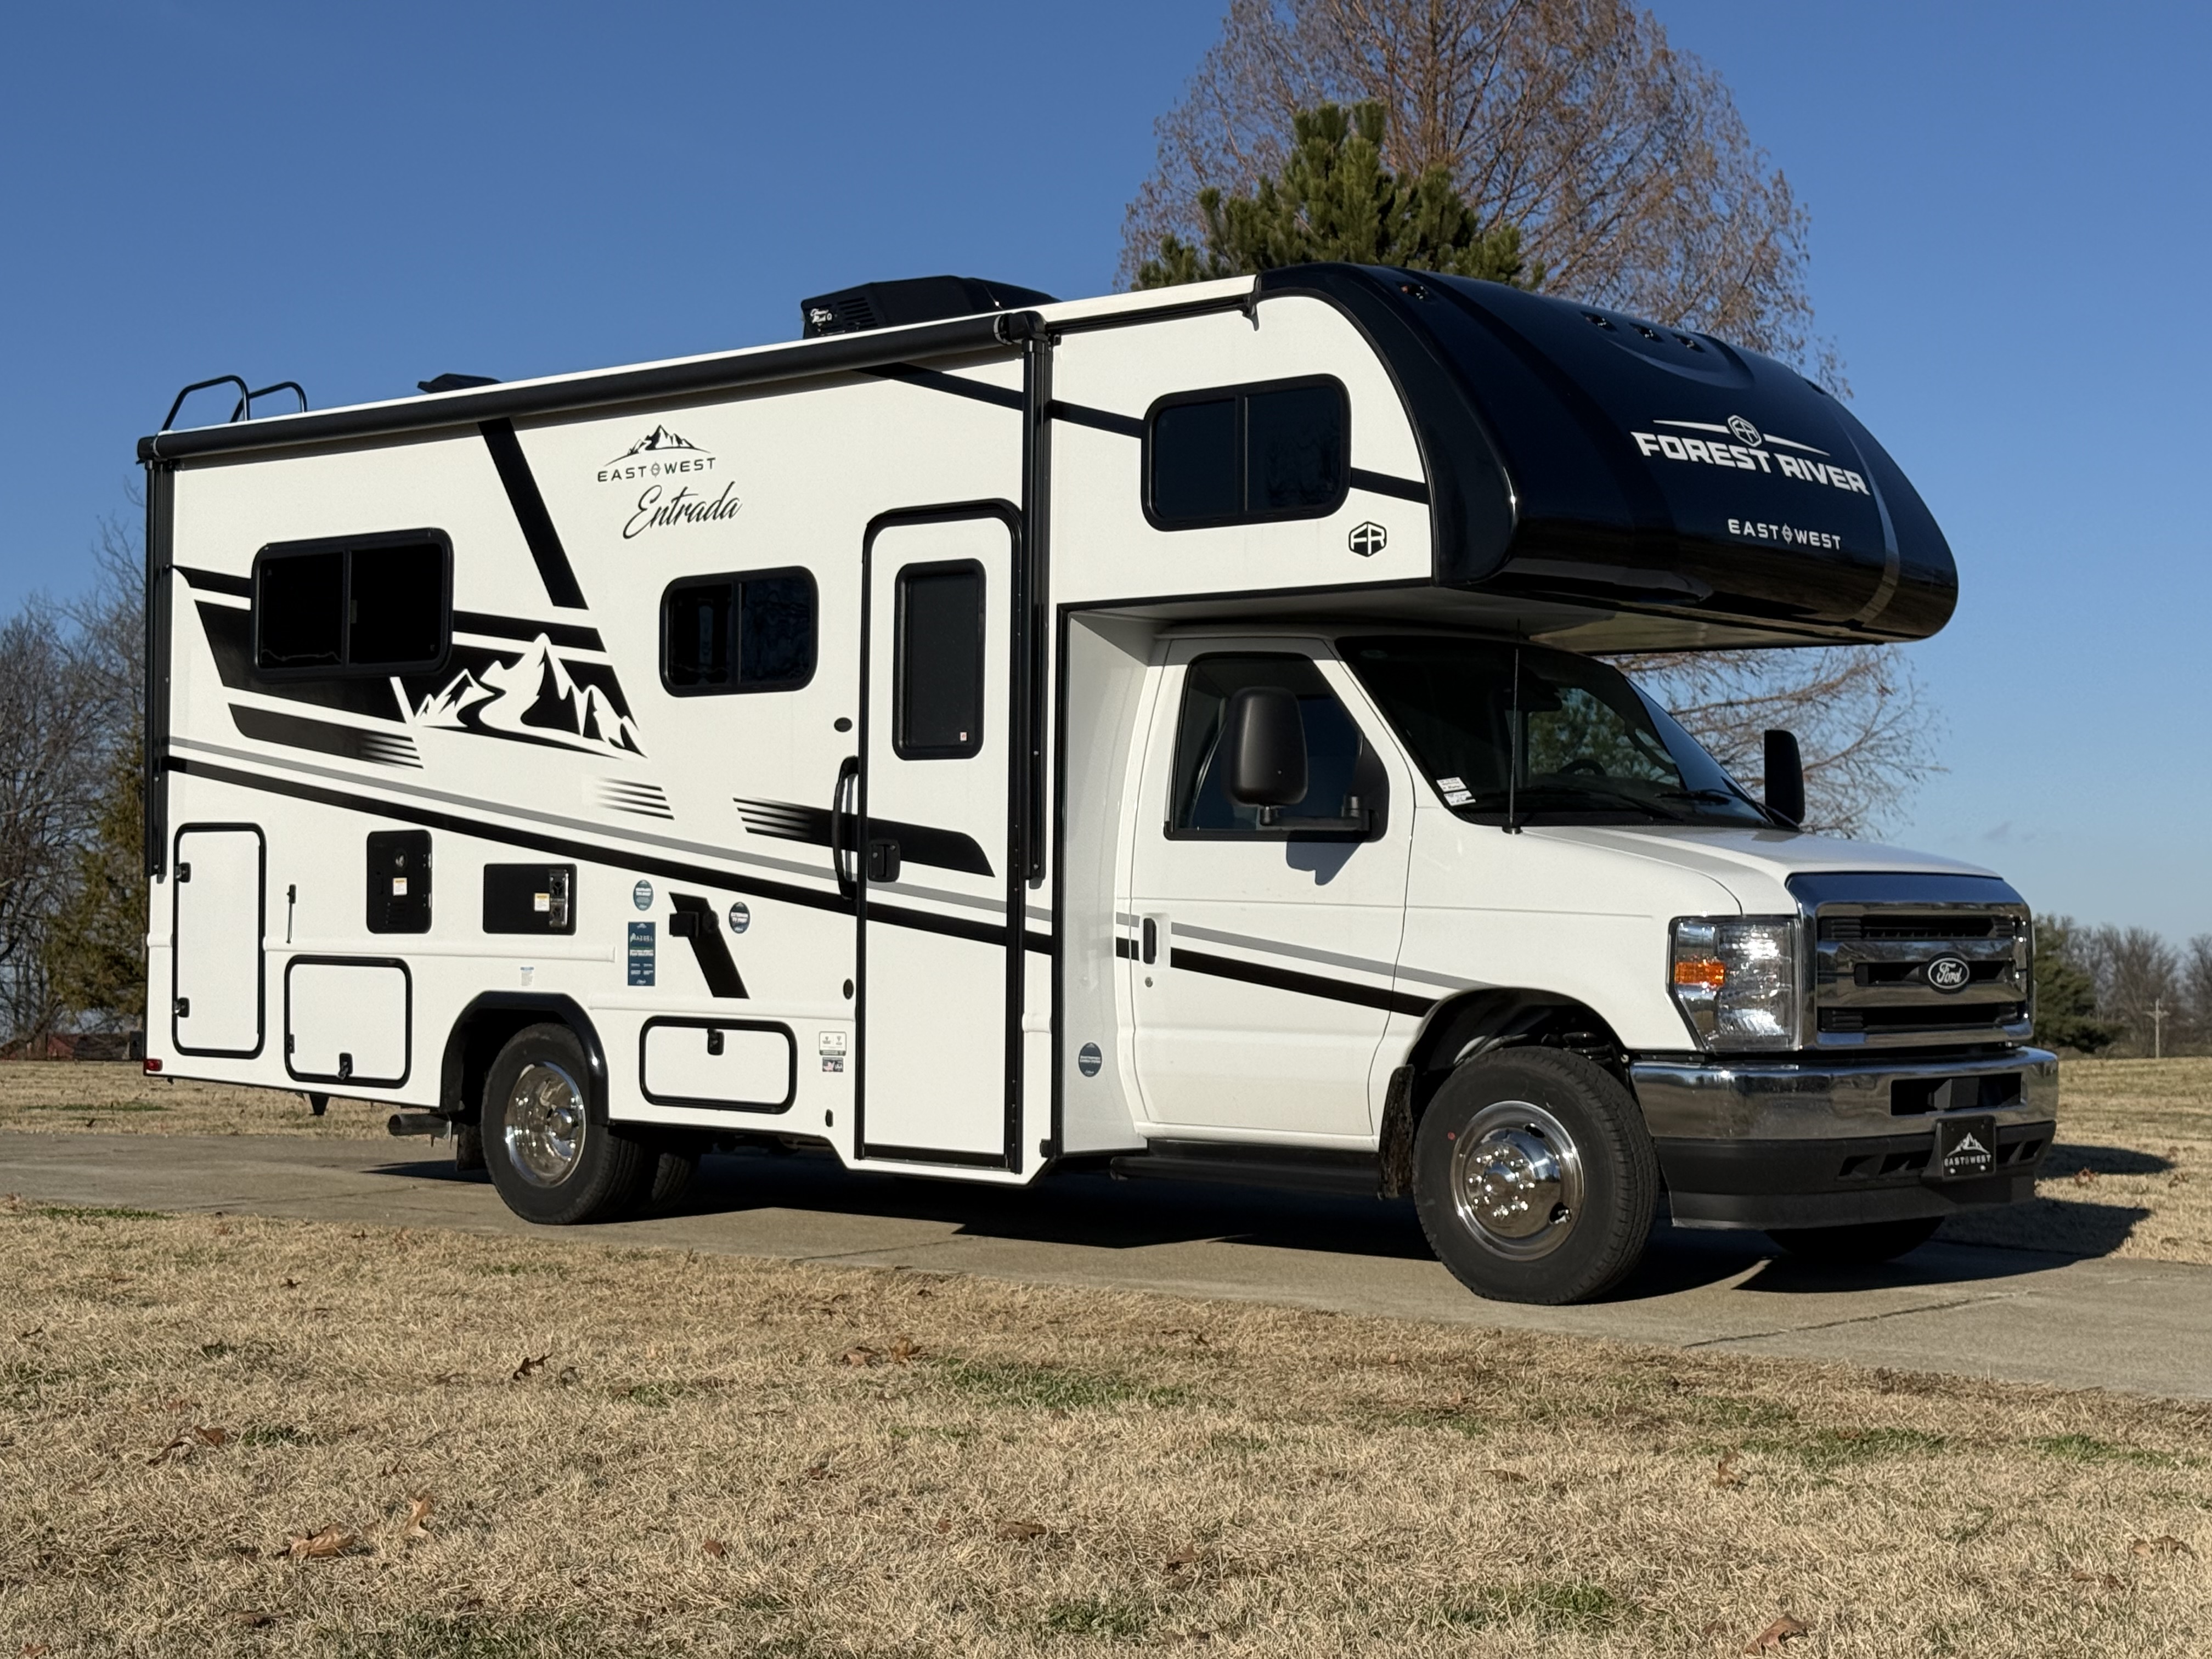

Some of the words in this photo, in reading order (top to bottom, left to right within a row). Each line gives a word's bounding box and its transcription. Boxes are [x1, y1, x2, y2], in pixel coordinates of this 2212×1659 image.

[597, 465, 646, 483] EAST
[664, 457, 716, 475] WEST
[1630, 431, 1772, 473] FOREST
[1774, 452, 1871, 496] RIVER
[622, 481, 743, 540] Entrada
[1727, 518, 1779, 540] EAST
[1792, 529, 1842, 551] WEST
[1936, 962, 1963, 984] Ford
[1944, 1156, 1965, 1167] EAST
[1970, 1154, 1991, 1164] WEST
